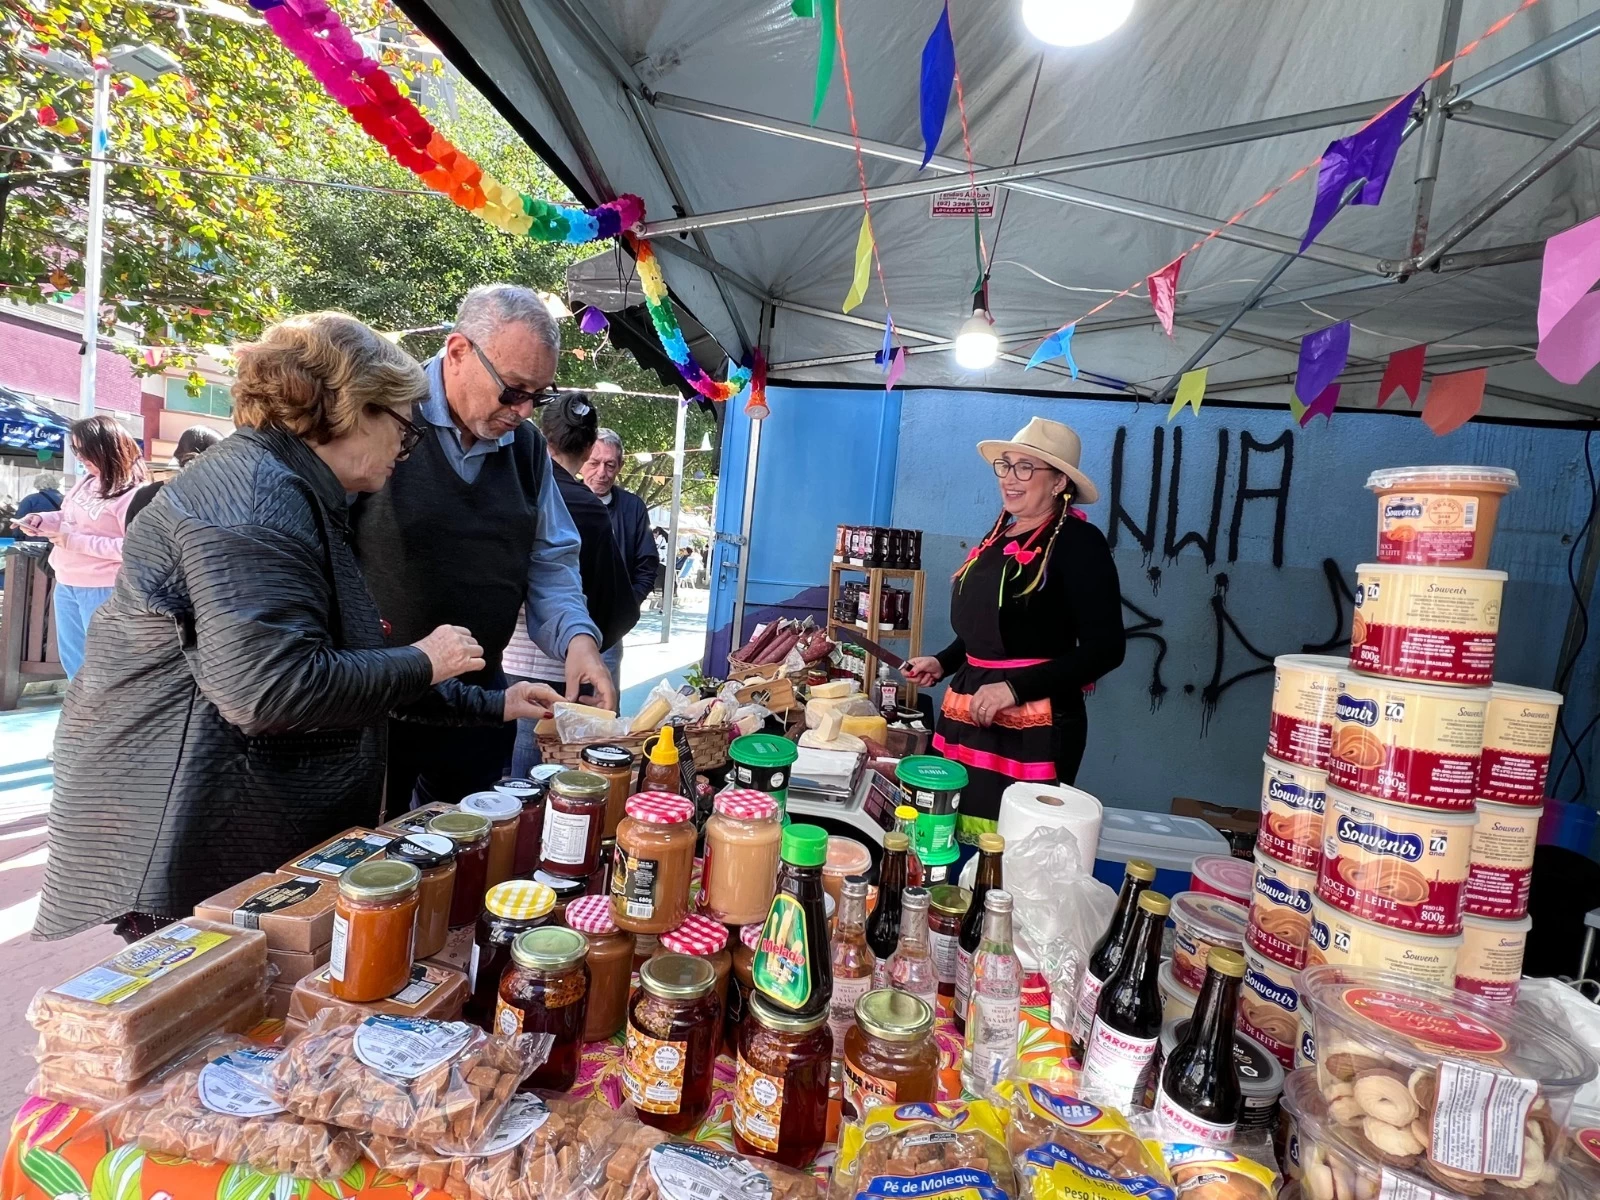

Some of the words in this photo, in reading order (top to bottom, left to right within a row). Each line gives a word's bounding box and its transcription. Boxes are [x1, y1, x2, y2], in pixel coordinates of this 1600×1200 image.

[1386, 506, 1421, 518] Souvenir
[1427, 584, 1467, 596] Souvenir
[1361, 651, 1379, 664] 800g
[1310, 682, 1337, 695] Souven
[1337, 760, 1357, 775] LEITE
[1378, 777, 1406, 792] 800g
[1274, 838, 1286, 849] DE
[1287, 841, 1313, 858] LEITE
[1340, 822, 1419, 859] Souvenir
[1430, 836, 1447, 852] 70
[1255, 875, 1308, 909] Souvenir
[1322, 875, 1345, 893] DOCE
[1346, 885, 1362, 900] DE
[1364, 894, 1399, 912] LEITE
[1420, 911, 1445, 925] 800g
[1257, 931, 1267, 943] DE
[1268, 935, 1292, 953] LEITE
[1335, 931, 1350, 946] 70
[761, 938, 806, 967] Melado
[1402, 949, 1440, 963] Souvenir
[1244, 968, 1298, 1008] Souvenir
[1099, 1026, 1142, 1054] XAROPE
[1256, 1030, 1280, 1050] LEITE
[865, 1079, 887, 1097] MEL
[1051, 1144, 1068, 1159] Pé
[1070, 1156, 1086, 1172] de
[885, 1180, 901, 1193] Pé
[906, 1181, 919, 1194] de
[922, 1173, 982, 1192] Moleque
[1072, 1169, 1090, 1185] em
